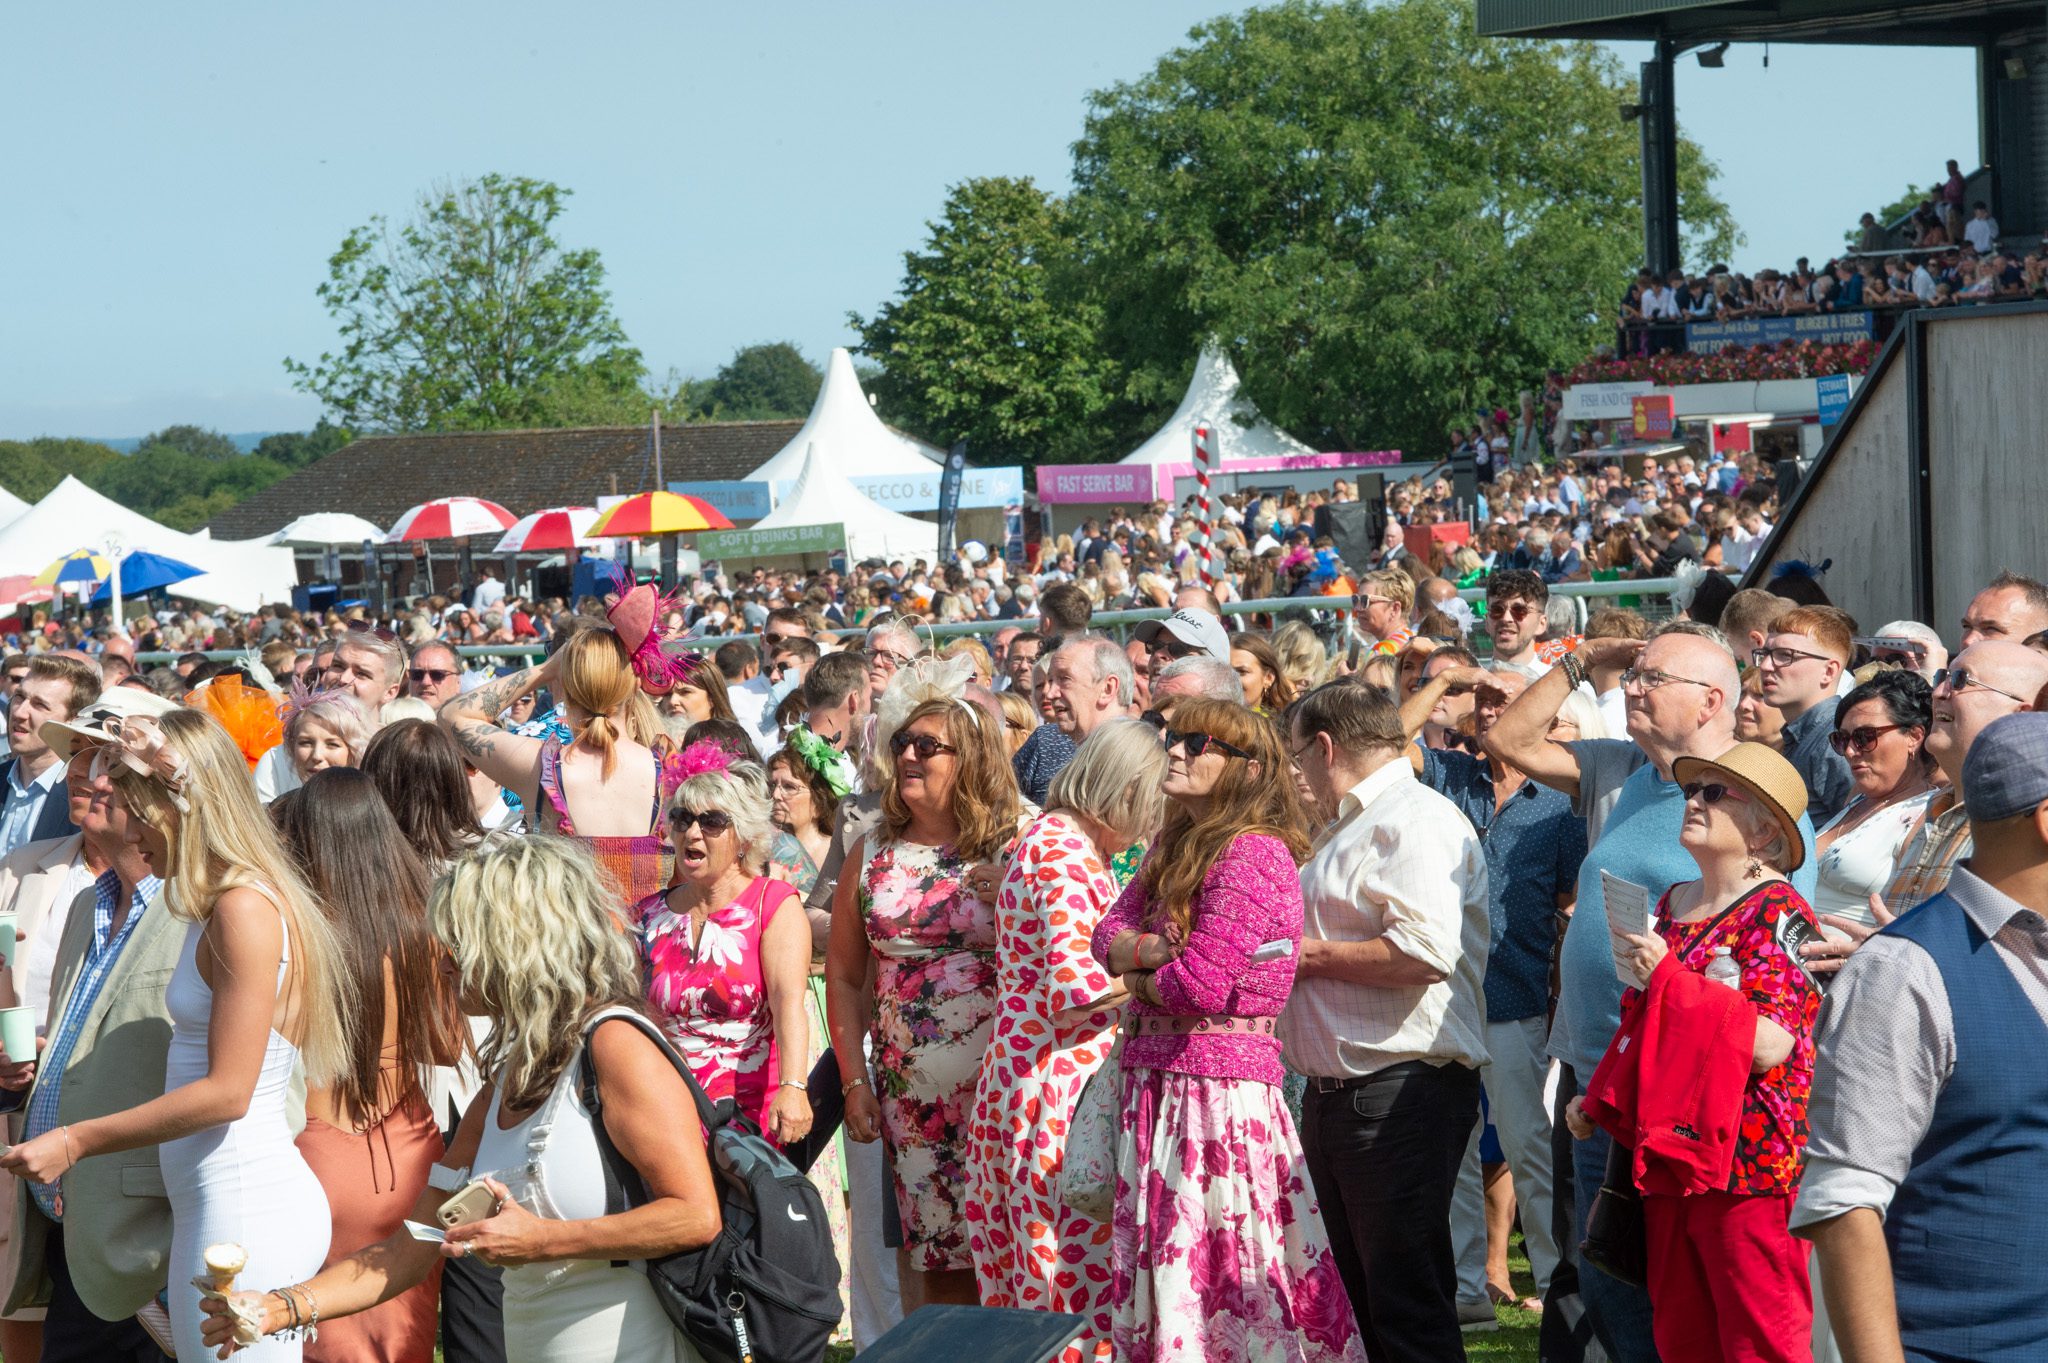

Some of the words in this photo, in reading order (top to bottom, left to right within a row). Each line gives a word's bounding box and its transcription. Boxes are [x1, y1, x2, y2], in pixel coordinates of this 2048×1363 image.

[1580, 393, 1598, 407] FISH
[1600, 392, 1619, 406] AND
[919, 482, 934, 497] &
[1056, 475, 1080, 493] FAST
[1082, 474, 1113, 493] SERVE
[1114, 474, 1134, 492] BAR
[719, 532, 750, 547] SOFT
[752, 528, 797, 544] DRINKS
[799, 526, 824, 540] BAR
[734, 1318, 746, 1335] JUST
[739, 1335, 748, 1347] DO
